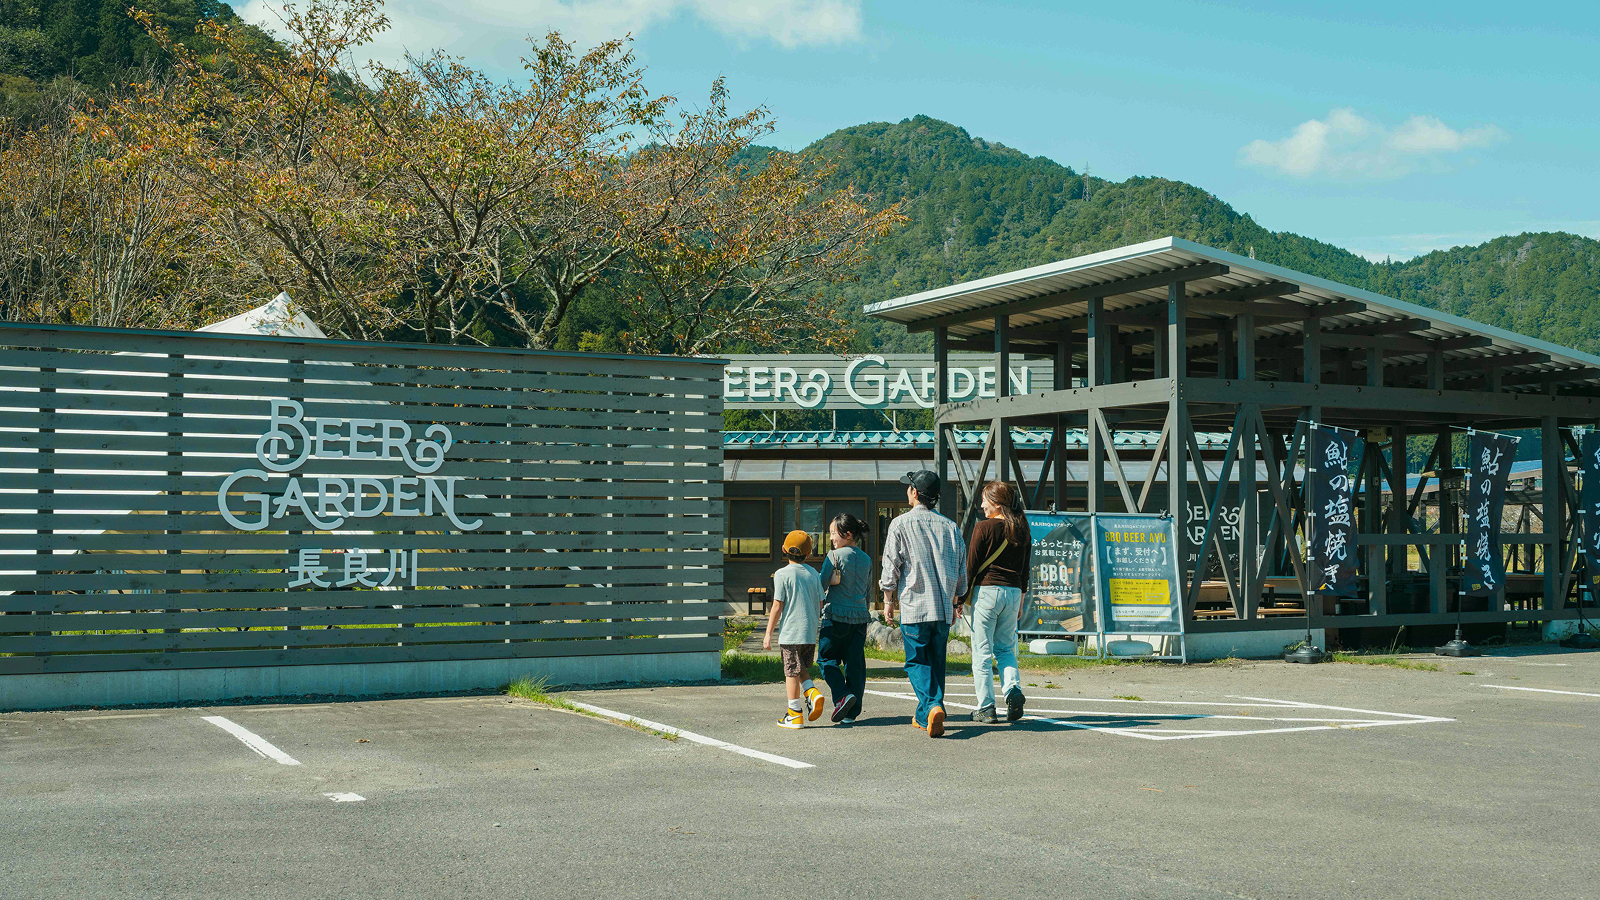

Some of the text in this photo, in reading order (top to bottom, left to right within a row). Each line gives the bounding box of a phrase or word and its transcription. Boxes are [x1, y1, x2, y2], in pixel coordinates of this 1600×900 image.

[724, 367, 830, 408] EER
[217, 468, 484, 531] GARDEN
[1324, 440, 1351, 591] 鮎の塩焼き
[1474, 446, 1503, 590] 鮎の塩焼き
[1032, 538, 1082, 549] ふらっと一杯
[1035, 549, 1081, 557] お気軽にどうぞ
[1105, 532, 1166, 543] BBQ BEER AYU
[288, 547, 418, 588] 長良川
[1040, 564, 1068, 584] BBQ
